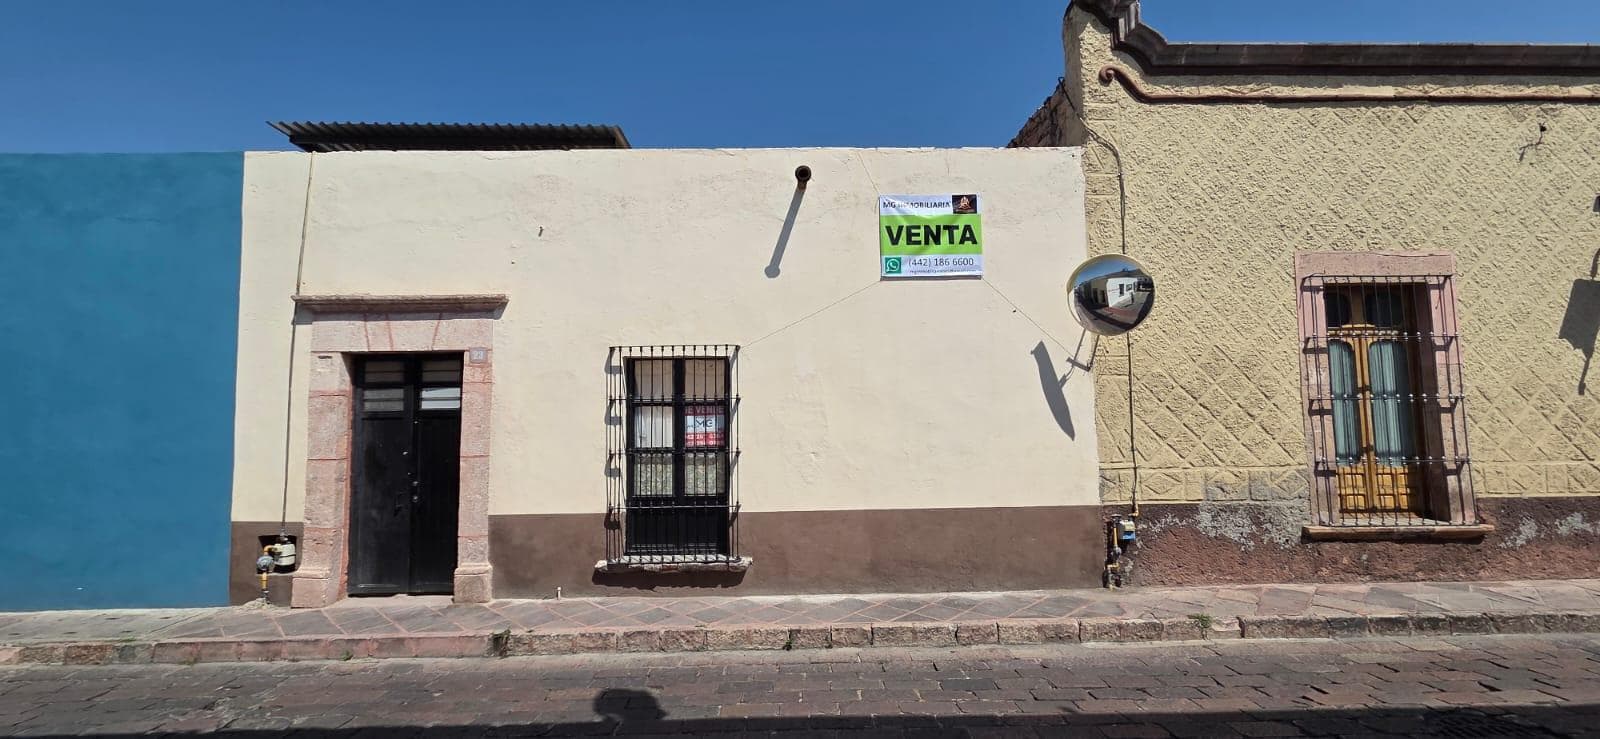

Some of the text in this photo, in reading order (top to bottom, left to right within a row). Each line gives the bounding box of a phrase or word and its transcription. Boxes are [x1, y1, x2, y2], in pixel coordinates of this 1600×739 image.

[883, 201, 896, 209] MG
[885, 224, 978, 245] VENTA
[908, 258, 931, 267] (442)
[953, 258, 974, 266] 6600
